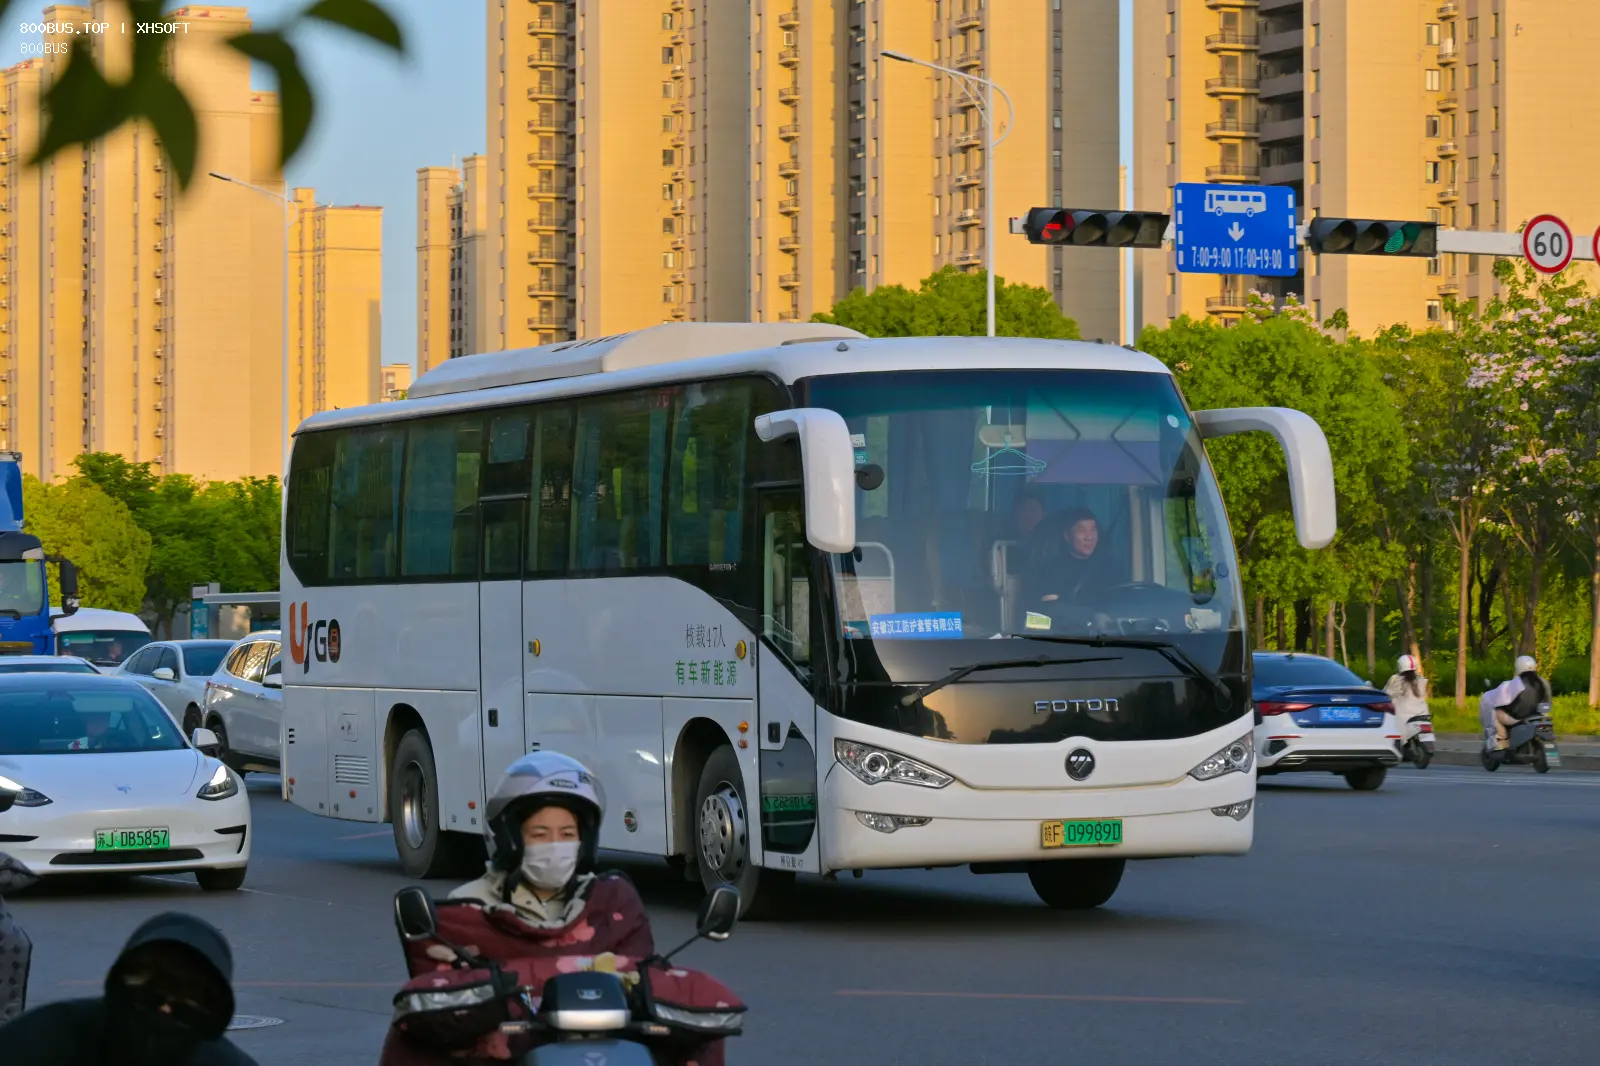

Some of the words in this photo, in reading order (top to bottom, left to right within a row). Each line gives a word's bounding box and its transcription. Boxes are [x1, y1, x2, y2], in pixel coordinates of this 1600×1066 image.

[1534, 231, 1563, 257] 60
[1191, 246, 1232, 268] 7:00-9:00
[1234, 247, 1282, 270] 17:00-19:00
[685, 623, 726, 648] 核载47人
[675, 660, 738, 686] 有车新能源
[1034, 698, 1119, 713] FOTON
